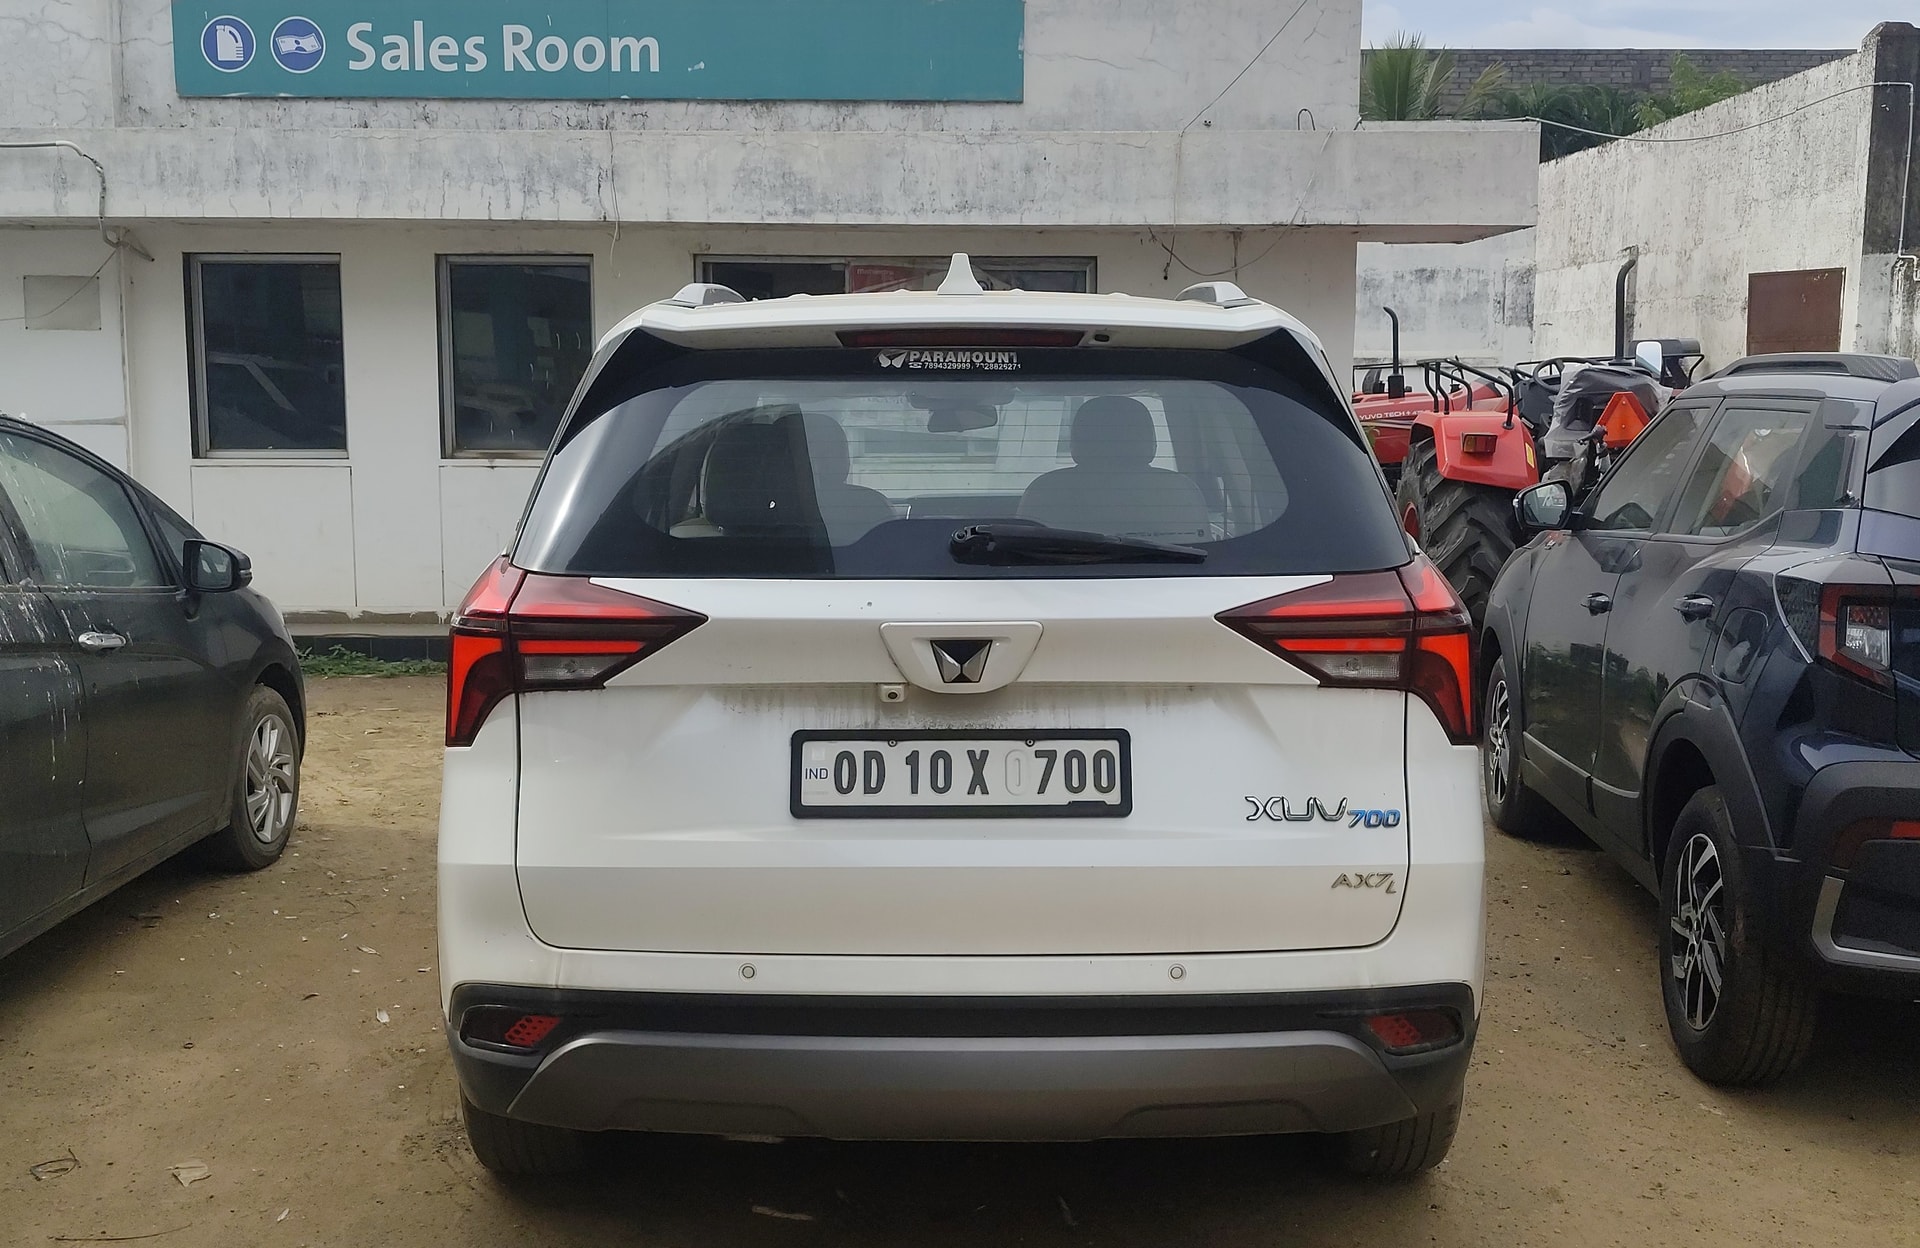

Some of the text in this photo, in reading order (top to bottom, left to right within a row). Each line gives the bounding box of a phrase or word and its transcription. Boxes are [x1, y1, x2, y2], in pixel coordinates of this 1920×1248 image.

[346, 20, 660, 72] Sales Room
[909, 351, 1018, 363] PARAMOUNT
[805, 767, 829, 780] IND
[905, 750, 952, 795] 10
